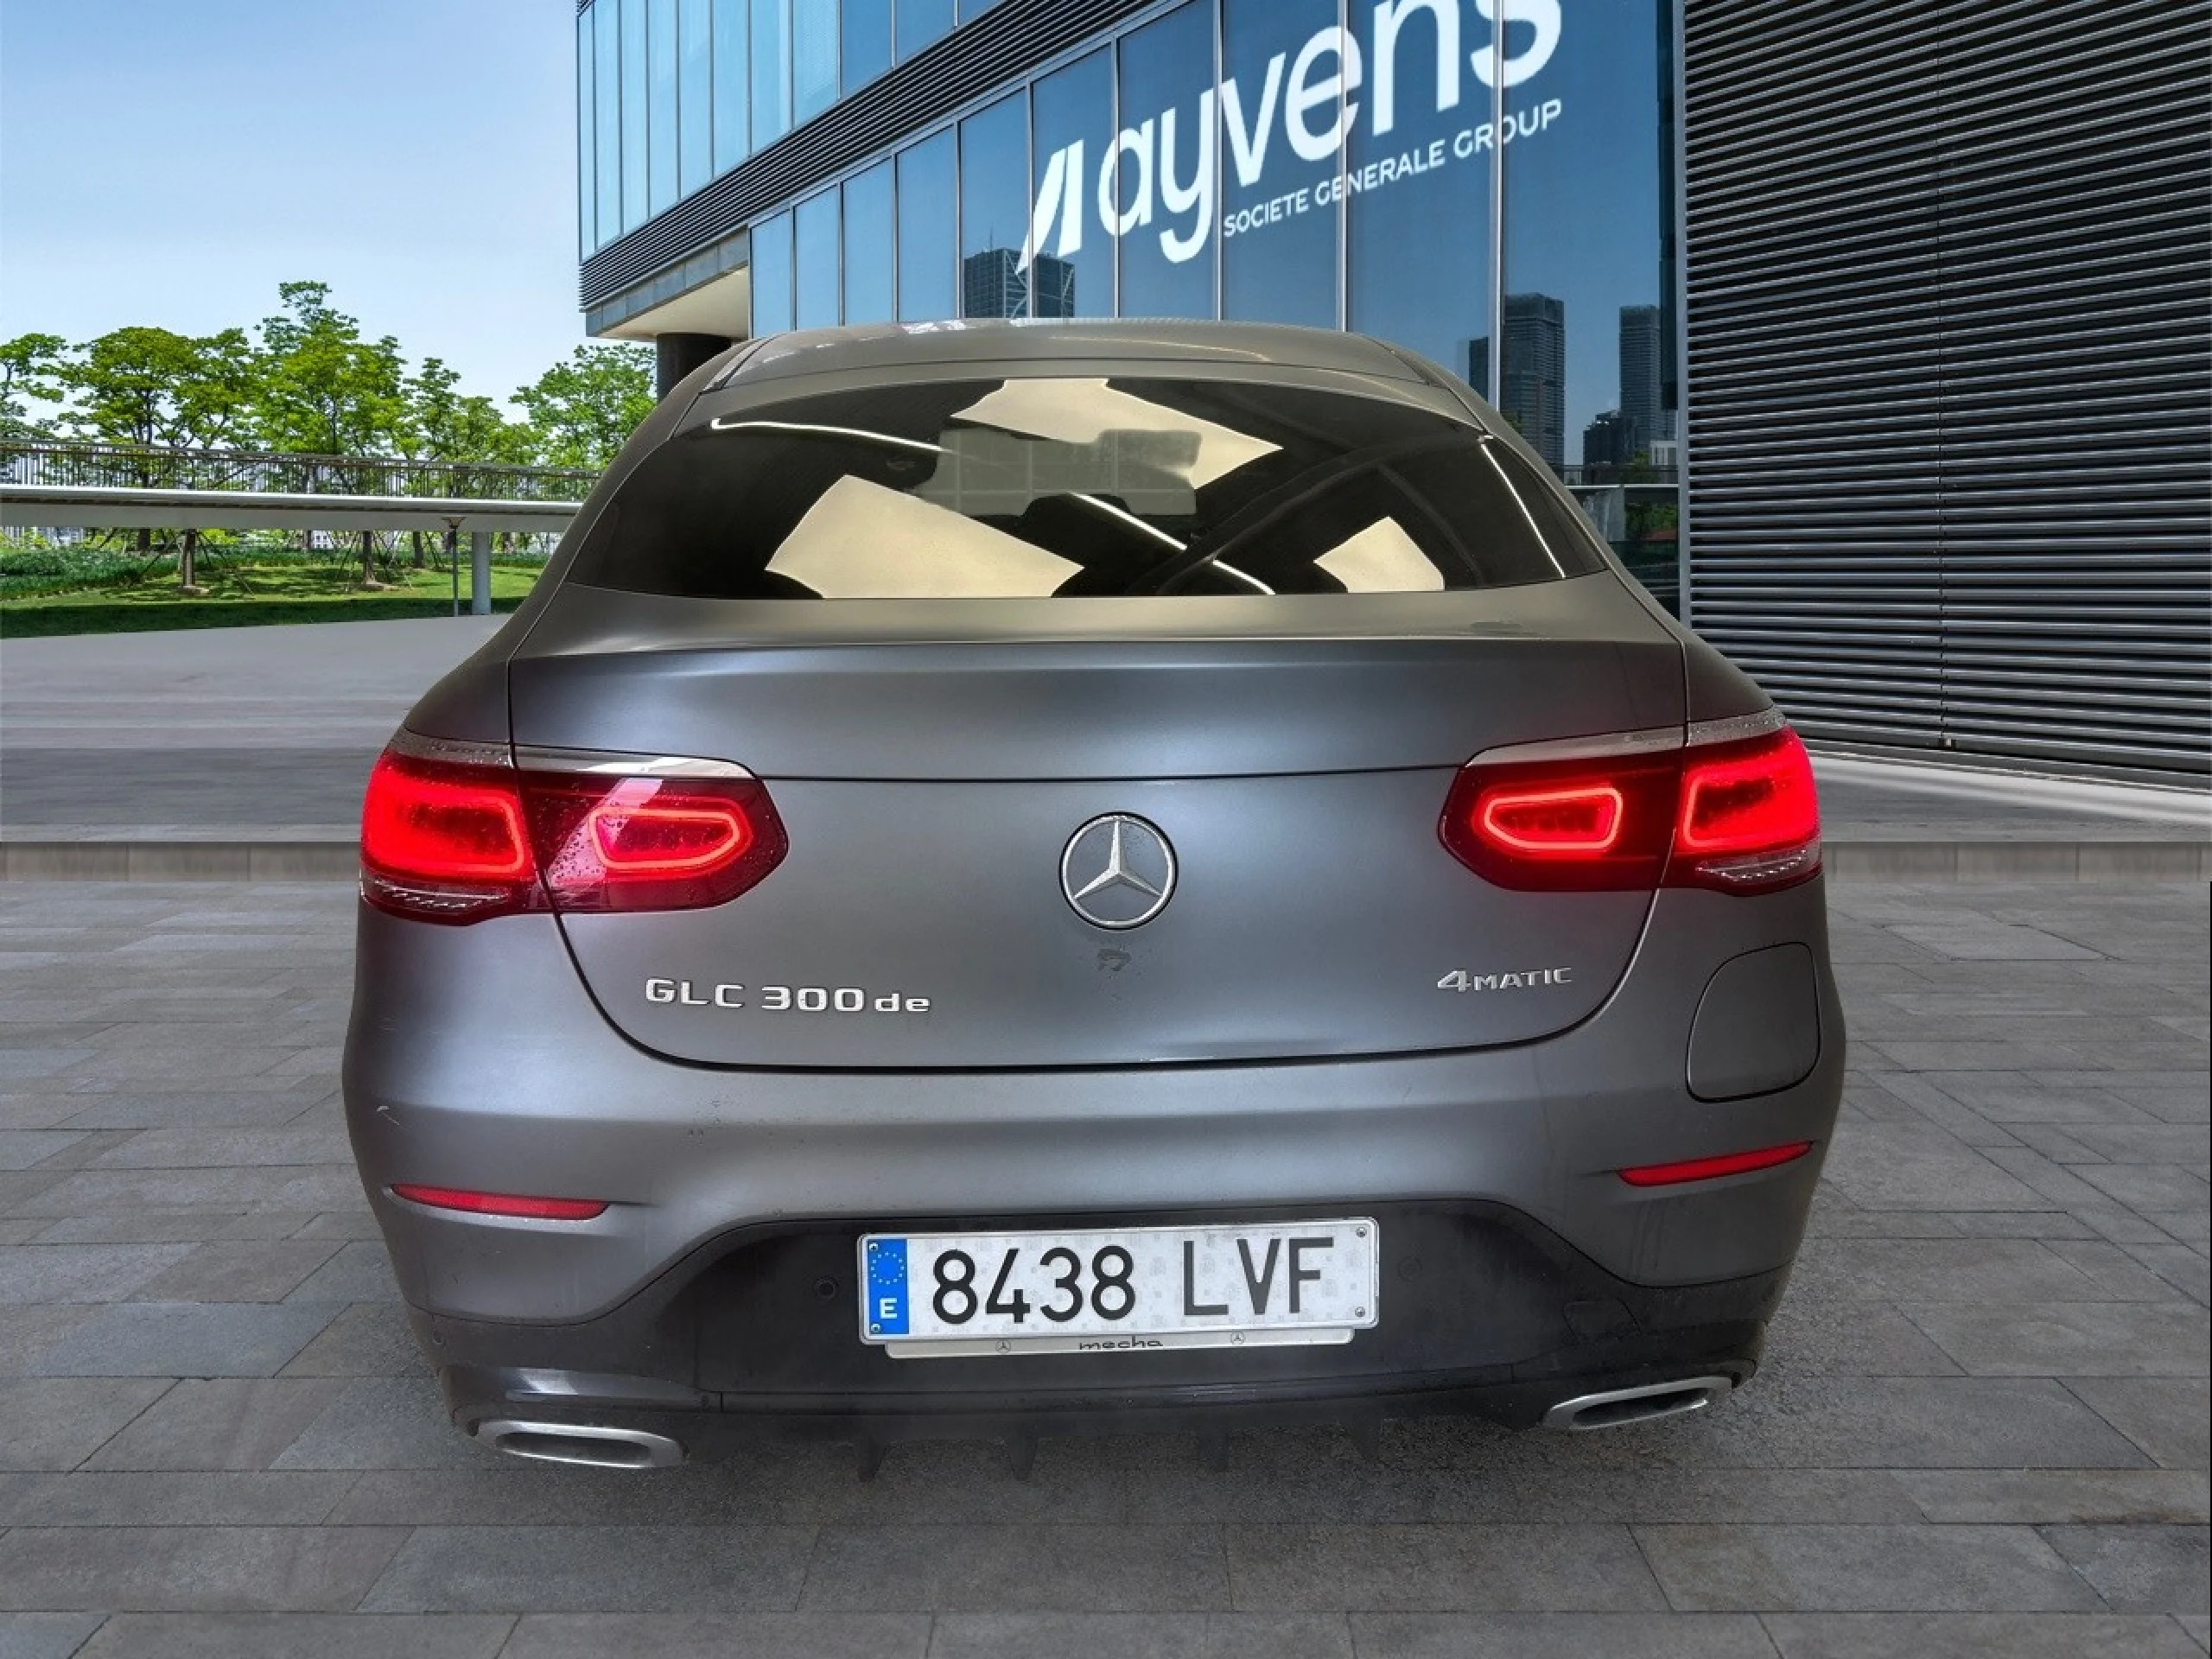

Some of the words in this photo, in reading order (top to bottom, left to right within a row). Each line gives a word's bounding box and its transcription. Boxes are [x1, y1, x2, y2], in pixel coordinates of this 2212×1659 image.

[1097, 0, 1561, 263] ayvens
[1224, 188, 1308, 238] SOCIETE
[1315, 139, 1446, 203] GENERALE
[1454, 98, 1561, 160] GROUP
[645, 977, 745, 1008] GLC
[761, 986, 865, 1012] 300
[874, 993, 930, 1012] de
[1437, 967, 1572, 993] 4MATIC
[932, 1244, 1135, 1325] 8438
[1183, 1236, 1335, 1318] LVF
[879, 1297, 898, 1319] E
[1078, 1335, 1164, 1351] mecha
